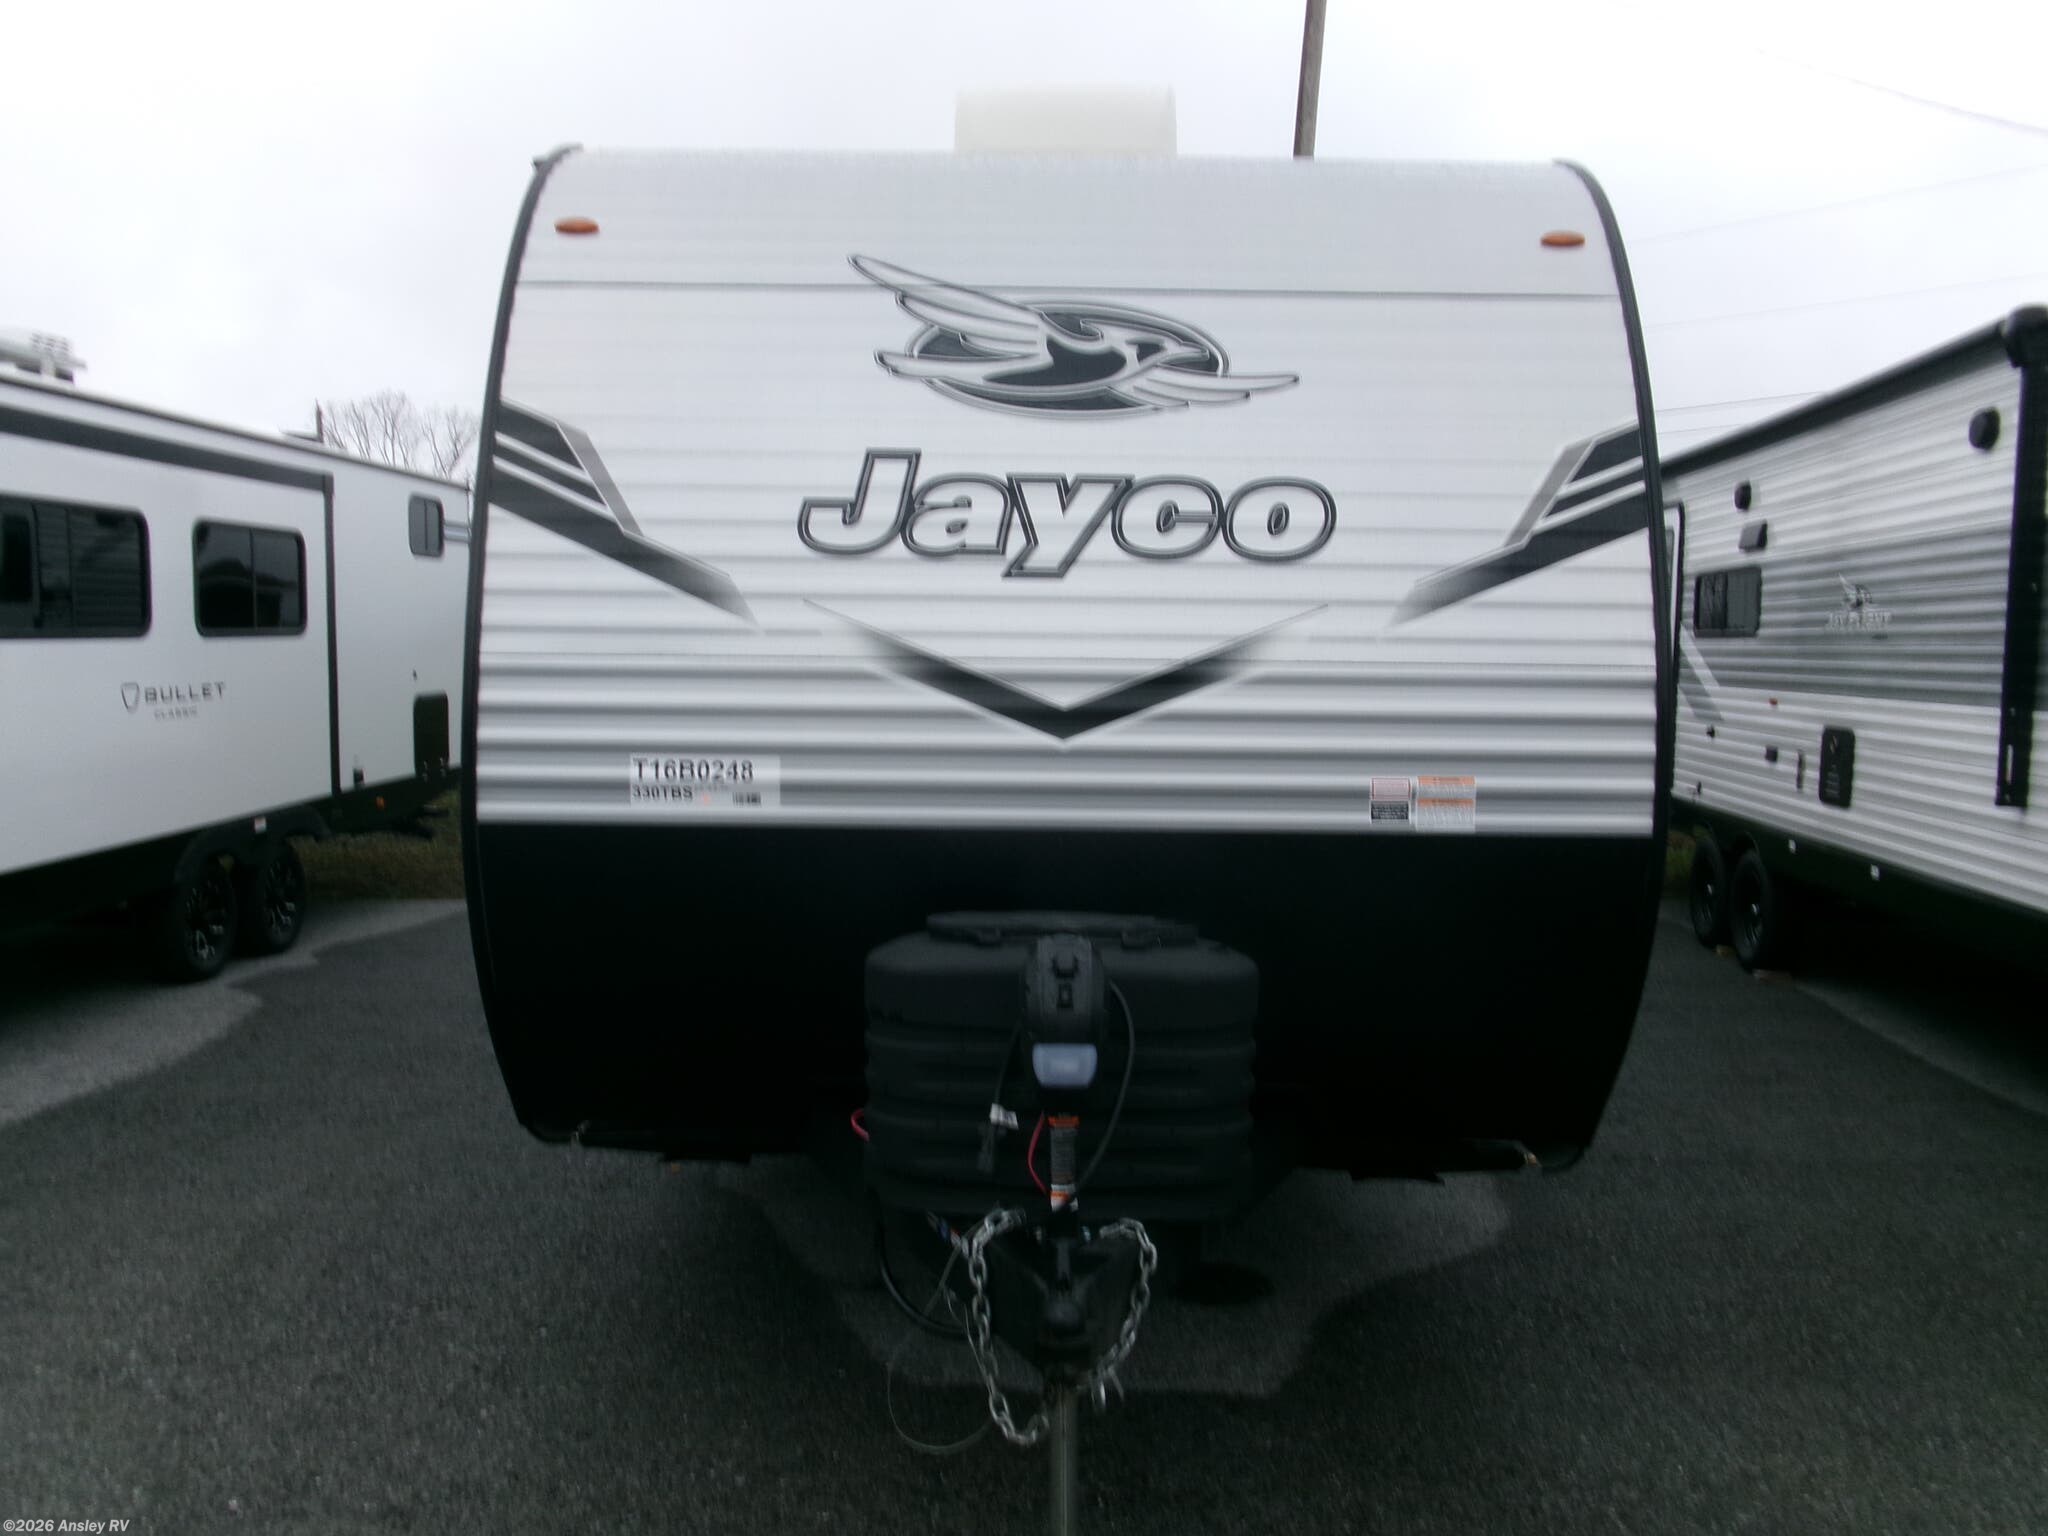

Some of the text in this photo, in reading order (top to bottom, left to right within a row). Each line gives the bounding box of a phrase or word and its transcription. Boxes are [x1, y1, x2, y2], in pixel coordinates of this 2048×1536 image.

[798, 447, 1337, 578] Jayco
[144, 681, 225, 703] BULLET
[632, 757, 753, 783] T16B0248
[632, 785, 693, 801] 330TBS
